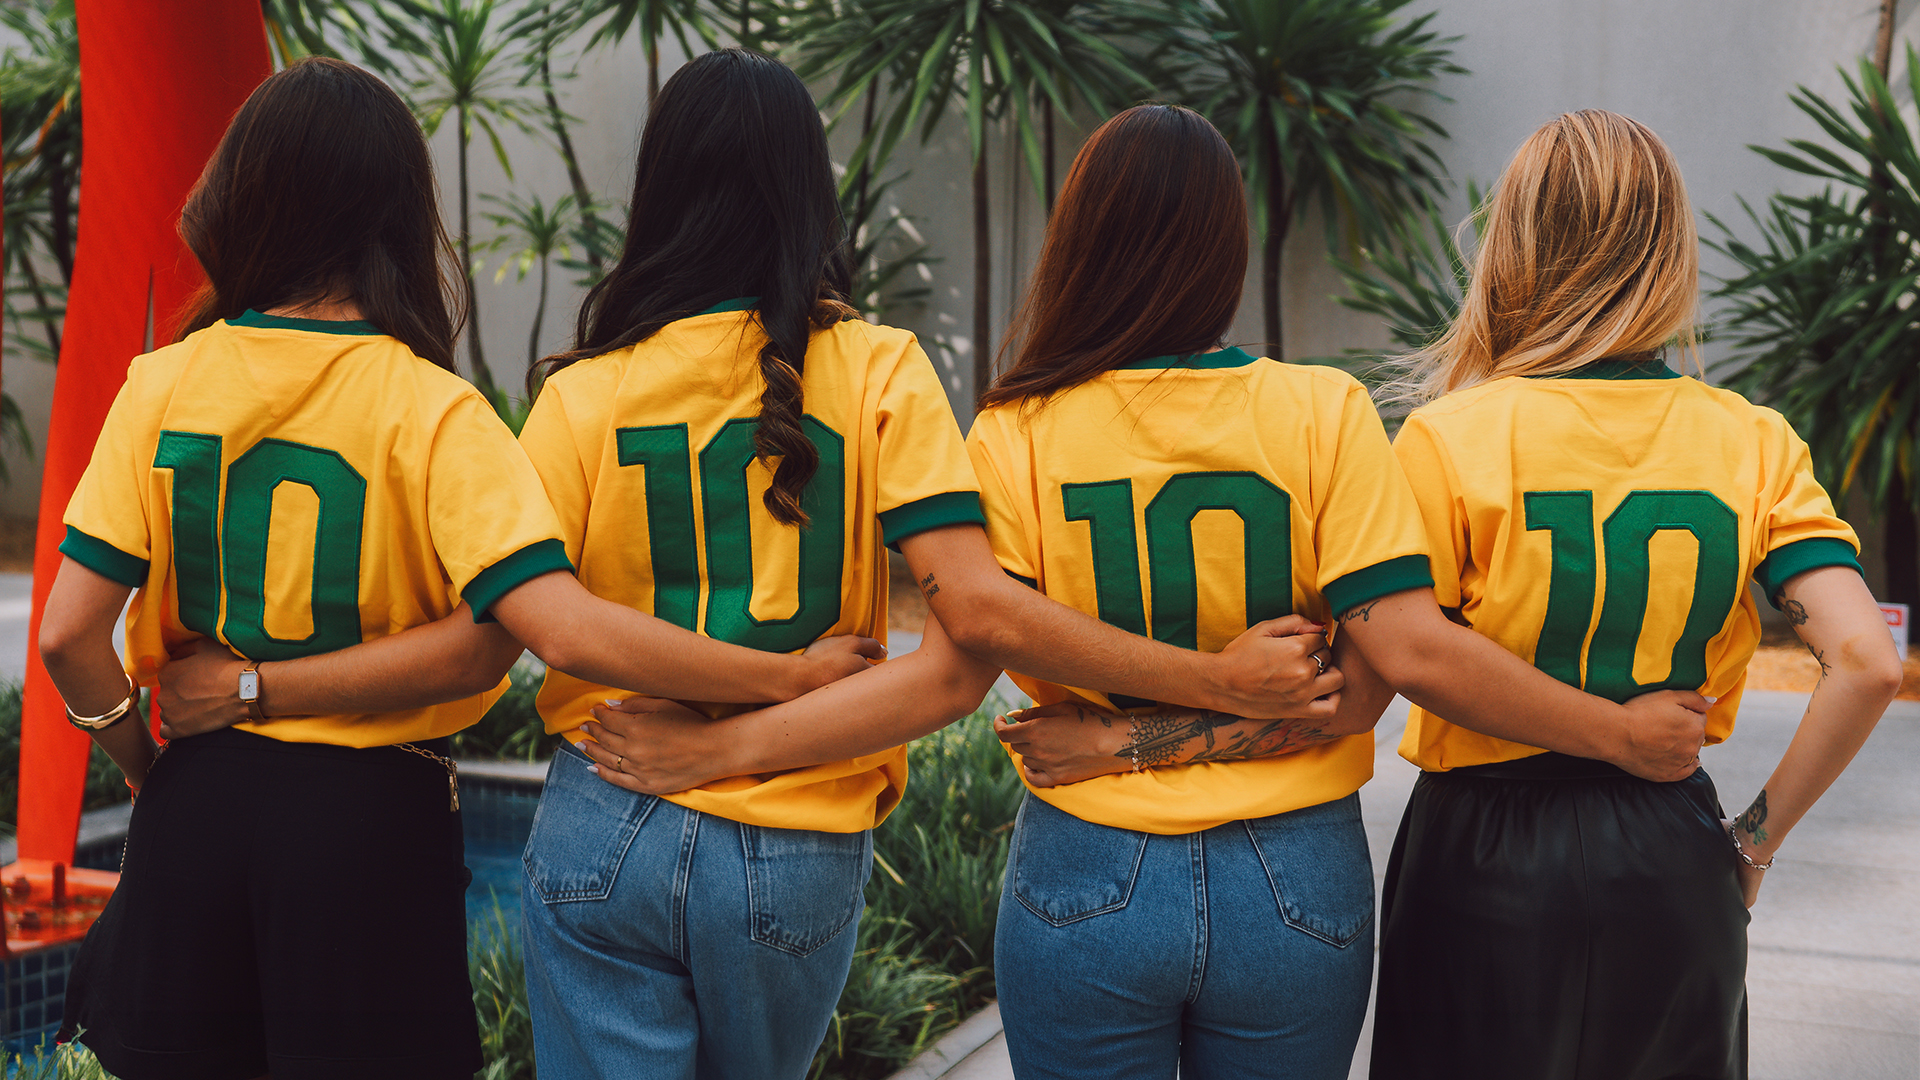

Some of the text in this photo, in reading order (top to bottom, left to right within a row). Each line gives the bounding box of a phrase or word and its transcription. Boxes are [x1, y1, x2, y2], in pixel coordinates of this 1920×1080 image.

[153, 430, 367, 661] 10
[616, 414, 845, 653] 10
[1061, 471, 1293, 652] 10
[1523, 490, 1739, 704] 10
